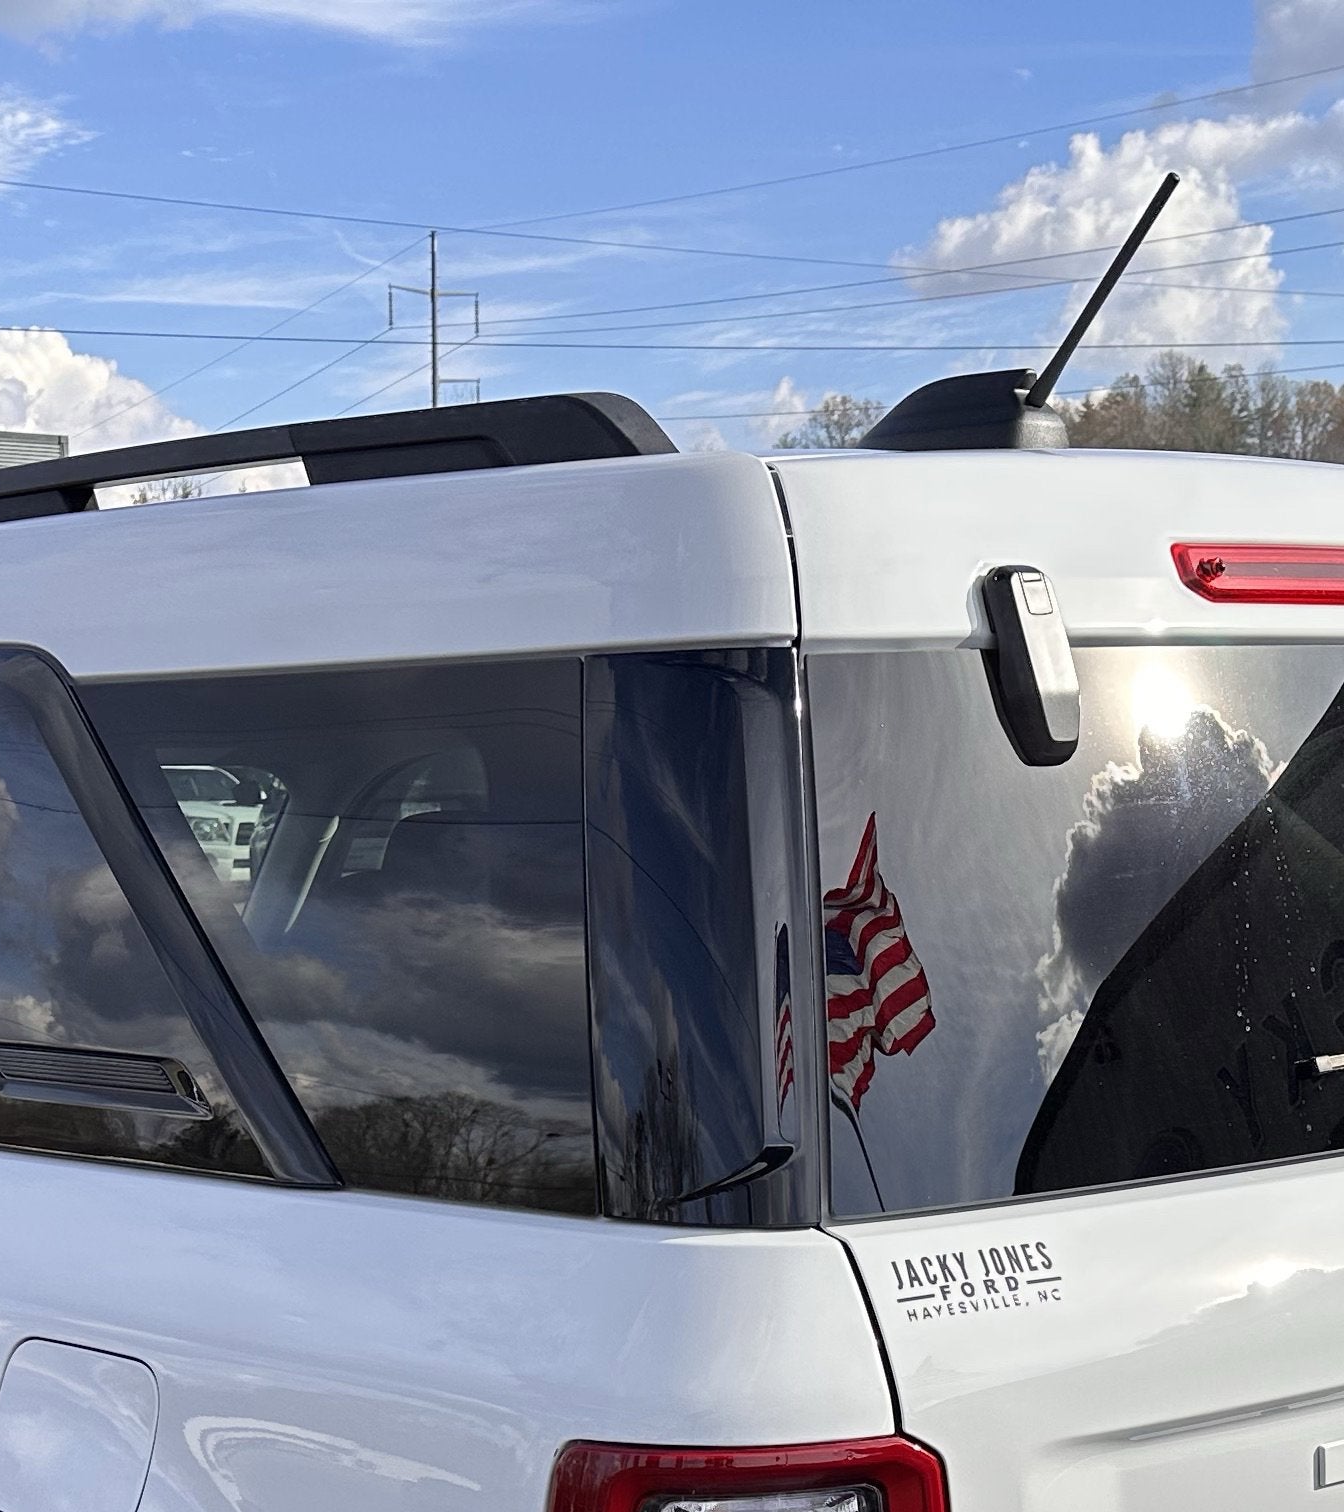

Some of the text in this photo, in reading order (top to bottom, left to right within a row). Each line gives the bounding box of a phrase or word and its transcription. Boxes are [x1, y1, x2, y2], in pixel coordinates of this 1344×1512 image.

[891, 1241, 1053, 1290] JACKY JONES
[906, 1287, 1062, 1322] HAYESVILLE, NC
[939, 1275, 1020, 1301] FORD
